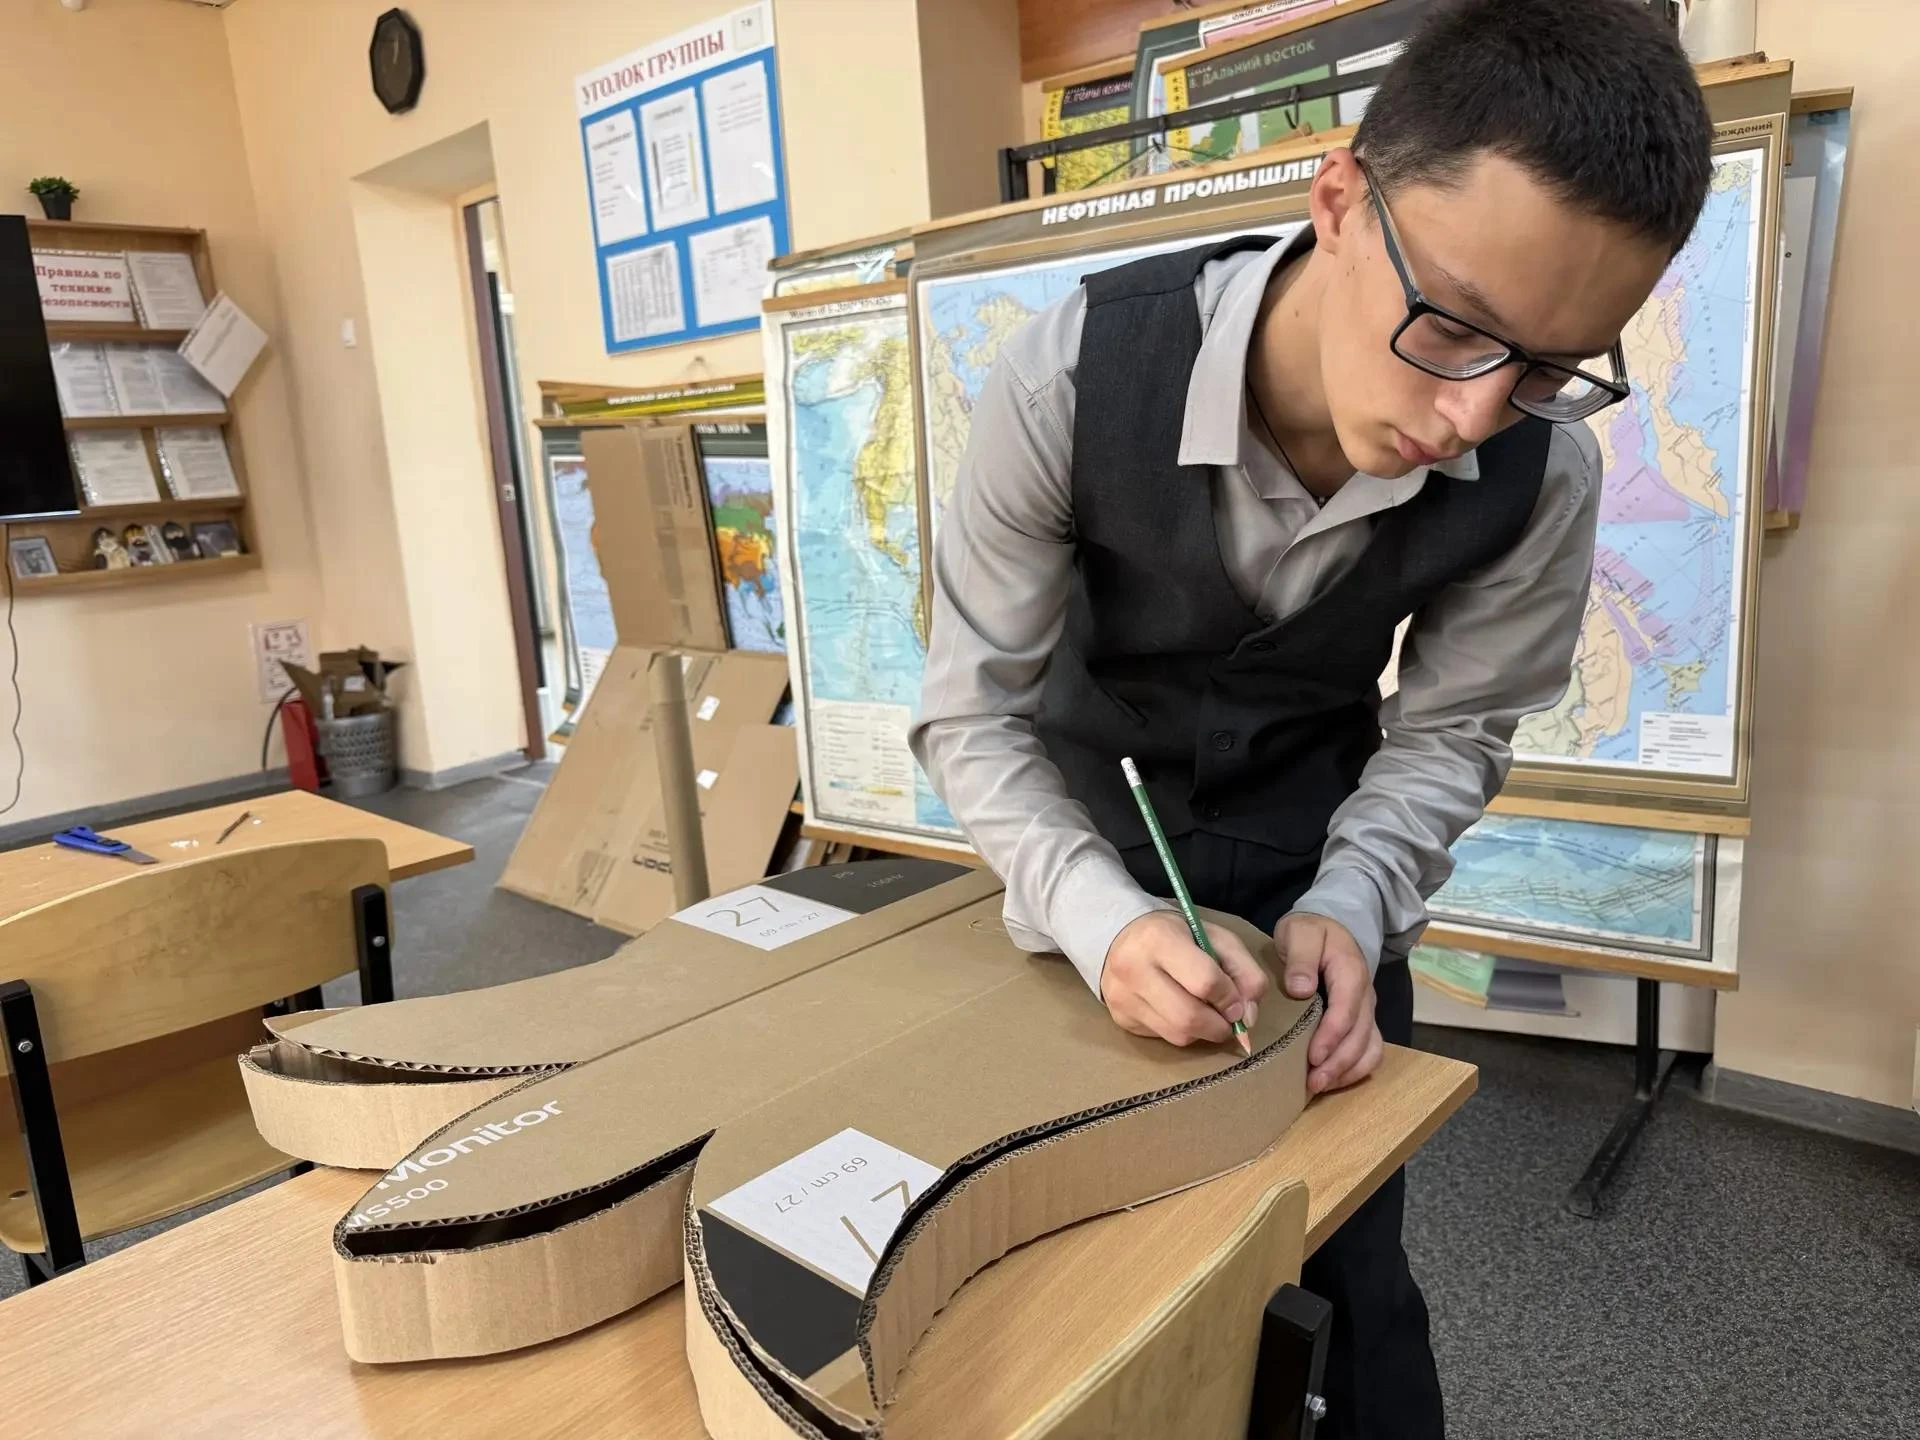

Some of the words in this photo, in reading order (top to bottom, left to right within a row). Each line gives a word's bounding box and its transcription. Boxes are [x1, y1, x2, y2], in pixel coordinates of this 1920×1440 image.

[582, 62, 644, 105] УГОЛОК
[647, 30, 725, 77] ГРУППЫ
[1202, 55, 1261, 86] ДАЛЬНИЙ
[1264, 41, 1316, 66] ВОСТОК
[1042, 189, 1156, 225] НЕФТЯНАЯ
[35, 265, 99, 279] Правила
[104, 269, 122, 279] по
[50, 284, 112, 294] технике
[706, 896, 780, 927] 27
[376, 1100, 563, 1190] Monitor
[841, 1157, 868, 1173] 69
[810, 1171, 840, 1189] cm
[775, 1195, 803, 1213] 27
